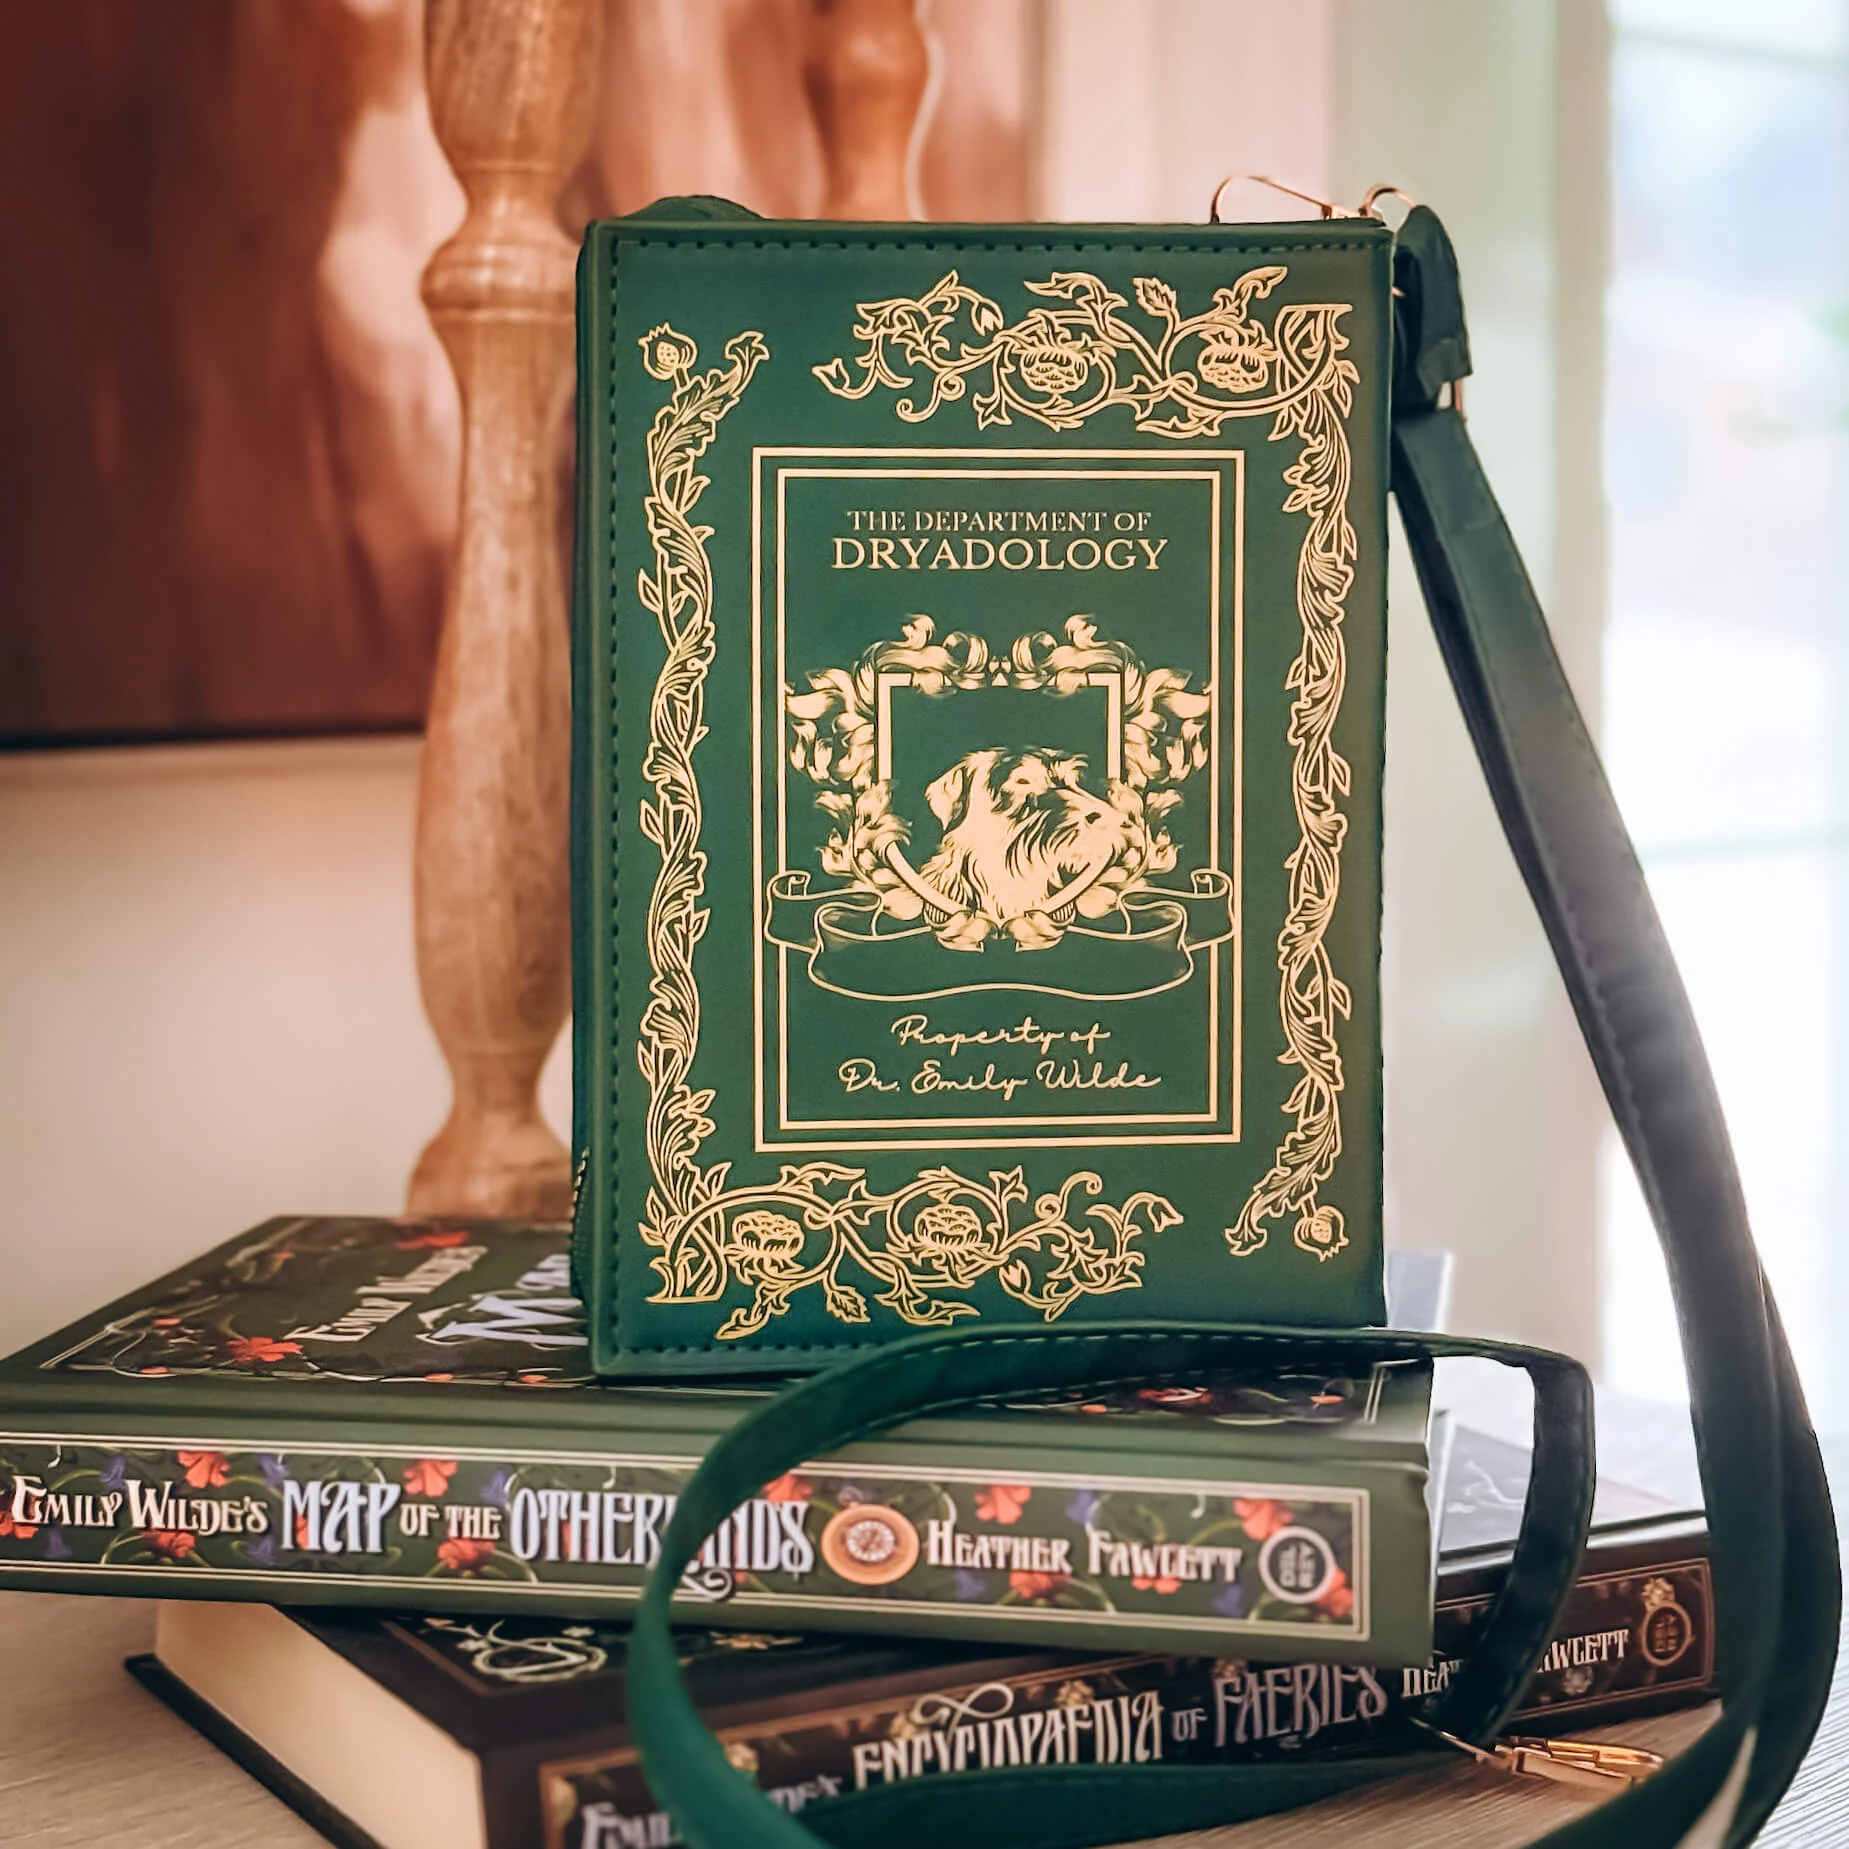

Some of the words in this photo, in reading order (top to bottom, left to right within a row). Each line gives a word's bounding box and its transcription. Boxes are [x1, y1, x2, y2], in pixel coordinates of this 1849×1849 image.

[847, 510, 905, 532] THE
[914, 510, 1107, 533] DEPARTMENT
[1113, 511, 1152, 533] OF
[832, 537, 1169, 571] DRYADOLOGY
[890, 1014, 1064, 1056] Property
[1069, 1023, 1112, 1055] of
[838, 1058, 901, 1092] Dr.
[911, 1059, 1028, 1101] Emily
[1035, 1059, 1162, 1090] Wilde
[280, 1478, 401, 1554] MAP
[401, 1502, 440, 1537] OF
[444, 1504, 502, 1541] THE
[1171, 1707, 1209, 1742] OF
